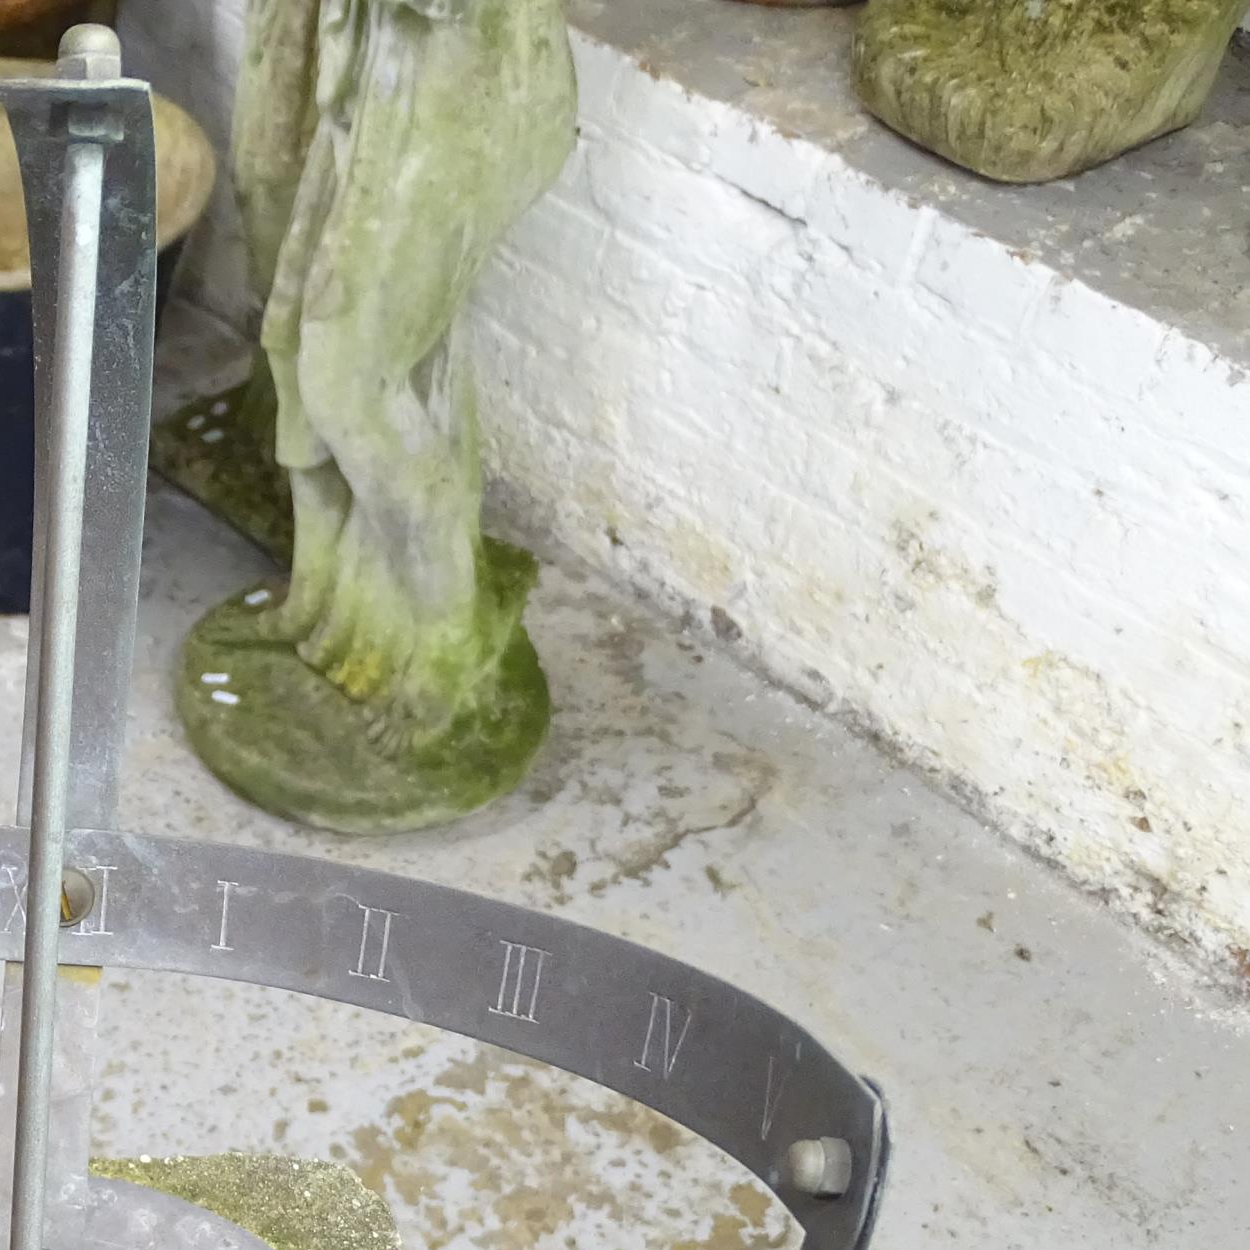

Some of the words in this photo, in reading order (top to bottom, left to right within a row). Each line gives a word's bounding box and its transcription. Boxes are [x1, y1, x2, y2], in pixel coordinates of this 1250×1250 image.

[1, 865, 118, 937] XI
[211, 879, 239, 950] I
[349, 904, 399, 982] II
[488, 938, 553, 1025] III
[633, 991, 692, 1079] IV
